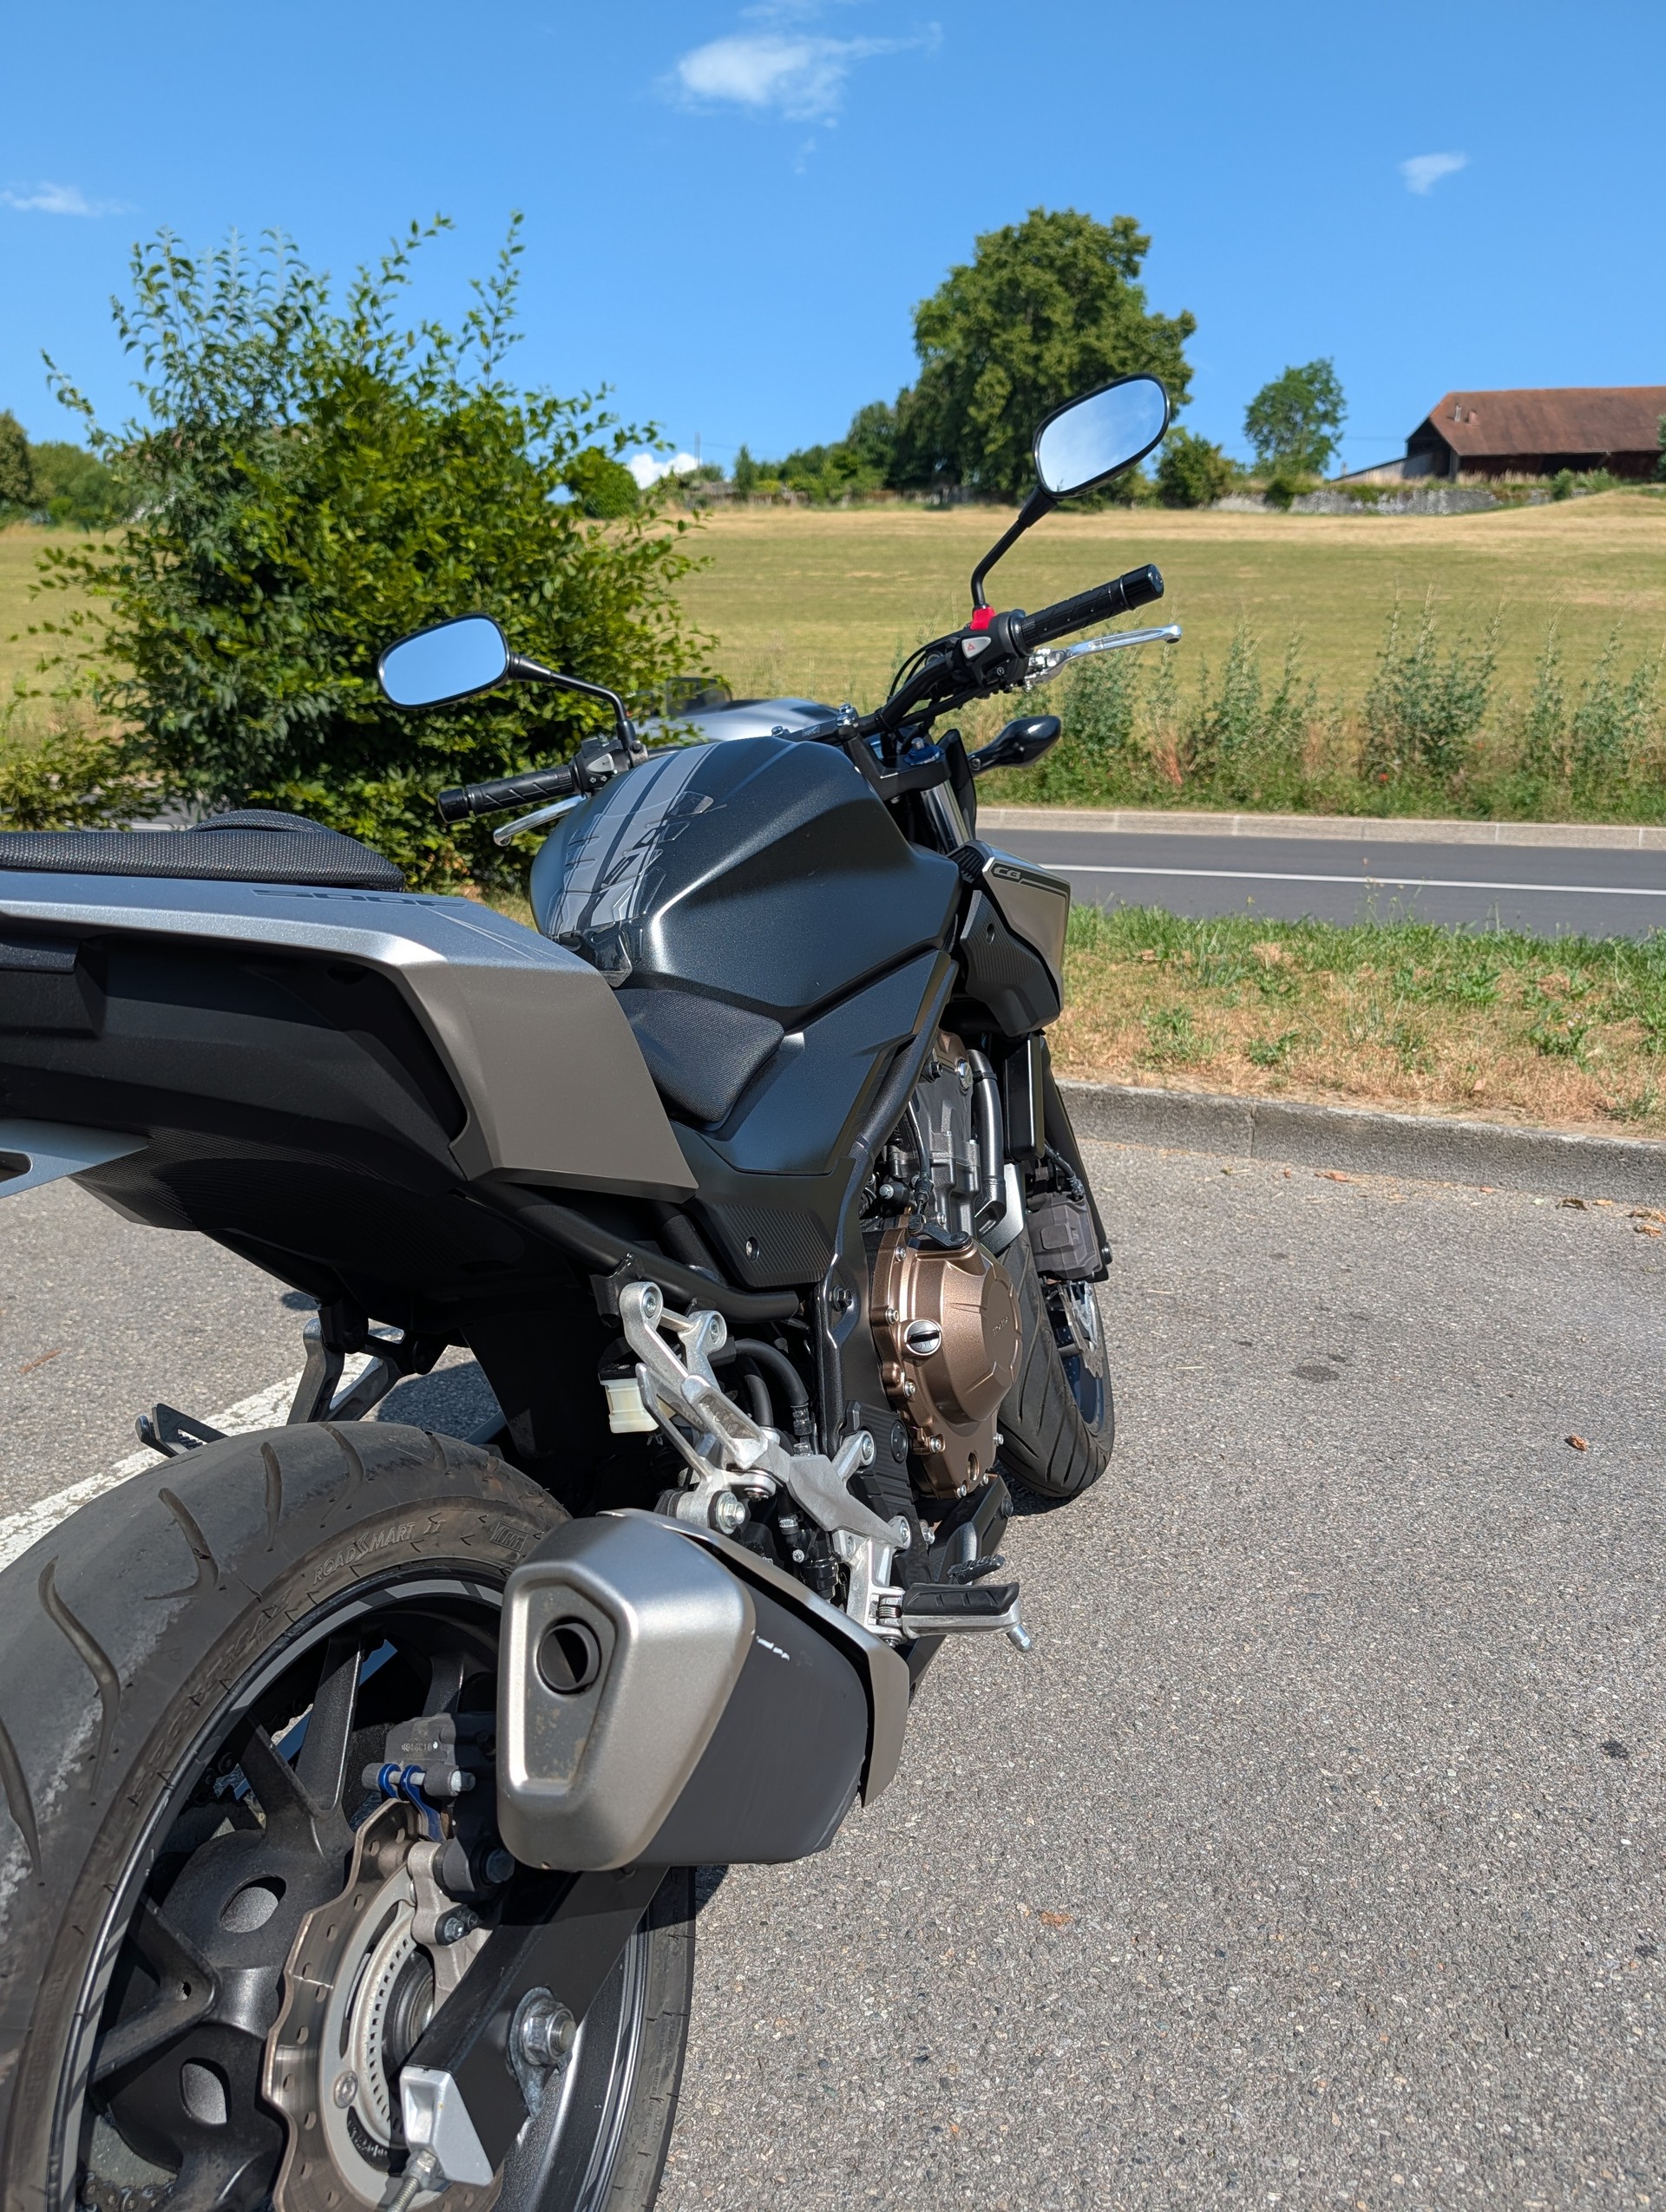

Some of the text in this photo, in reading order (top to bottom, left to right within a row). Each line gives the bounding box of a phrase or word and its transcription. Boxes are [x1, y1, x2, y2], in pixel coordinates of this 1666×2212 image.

[993, 867, 1021, 880] CB
[250, 889, 468, 908] 500F
[312, 1522, 416, 1585] ROADSMART
